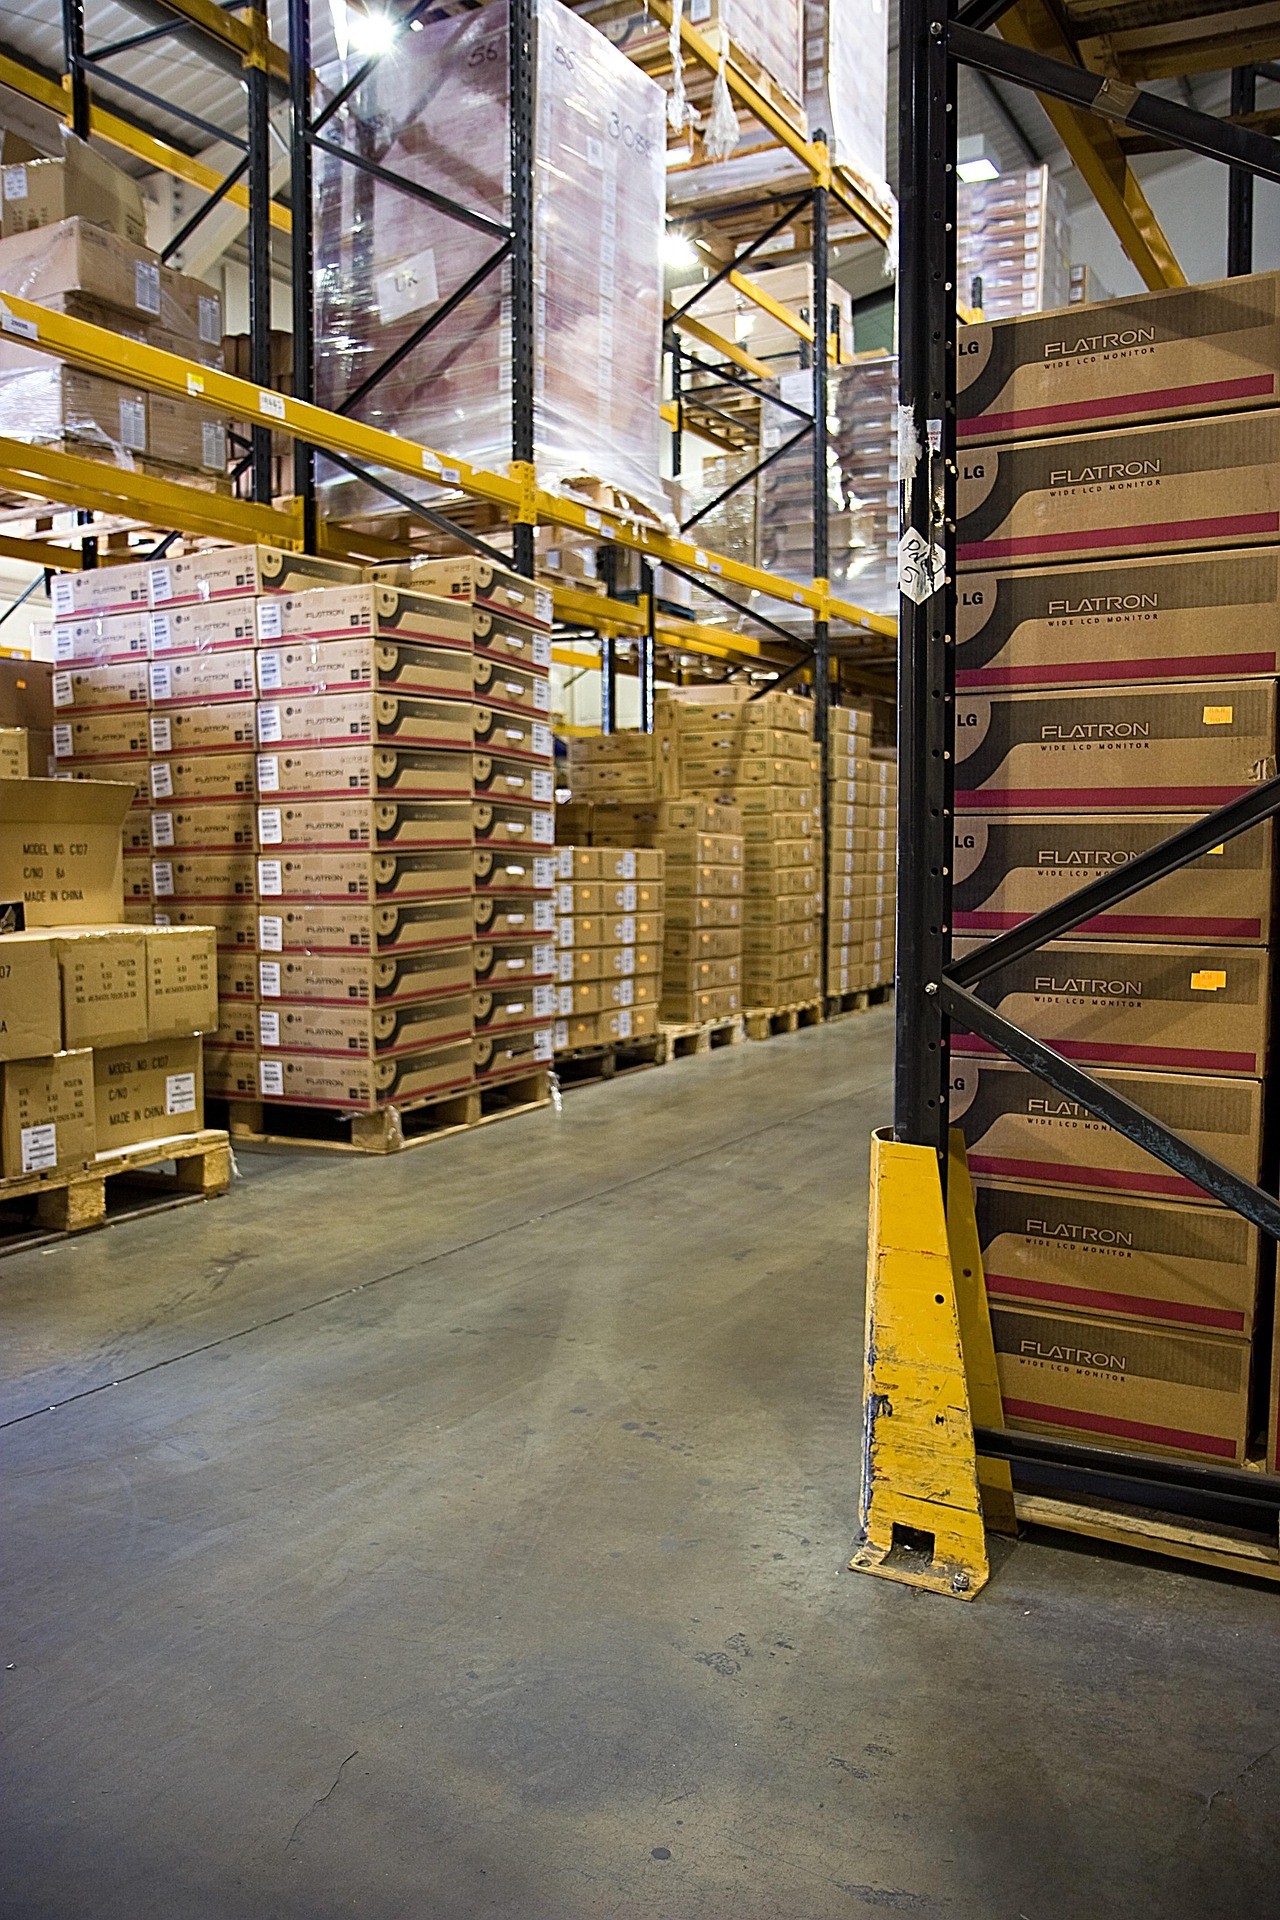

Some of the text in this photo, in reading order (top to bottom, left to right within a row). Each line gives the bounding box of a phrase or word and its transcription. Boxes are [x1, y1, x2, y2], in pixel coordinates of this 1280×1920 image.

[958, 342, 979, 356] LG
[1044, 327, 1155, 357] FLATRON
[1044, 347, 1155, 369] WIDE LCD MONITOR
[964, 466, 985, 479] LG
[1050, 459, 1161, 485] FLATRON
[1050, 479, 1161, 497] WIDE LCD MONITOR
[962, 592, 983, 605] LG
[1048, 594, 1158, 615] FLATRON
[1107, 613, 1158, 622] MONITOR
[957, 714, 977, 727] LG
[1041, 722, 1150, 739] FLATRON
[1099, 742, 1150, 750] MONITOR
[23, 843, 49, 856] MODEL
[954, 836, 975, 848] LG
[23, 866, 44, 879] C/NO
[24, 889, 84, 902] MADE IN CHINA
[1034, 977, 1142, 995] FLATRON
[1034, 996, 1059, 1004] WIDE
[1092, 999, 1142, 1008] MONITOR
[108, 1061, 132, 1075] MODEL
[109, 1105, 165, 1125] MADE IN CHINA
[1027, 1117, 1052, 1126] WIDE
[1084, 1123, 1114, 1132] MONI
[1026, 1219, 1132, 1245] FLATRON
[1025, 1238, 1132, 1258] WIDE LCD MONITOR
[1020, 1340, 1126, 1370] FLATRON
[1020, 1359, 1126, 1382] WIDE LCD MONITOR
